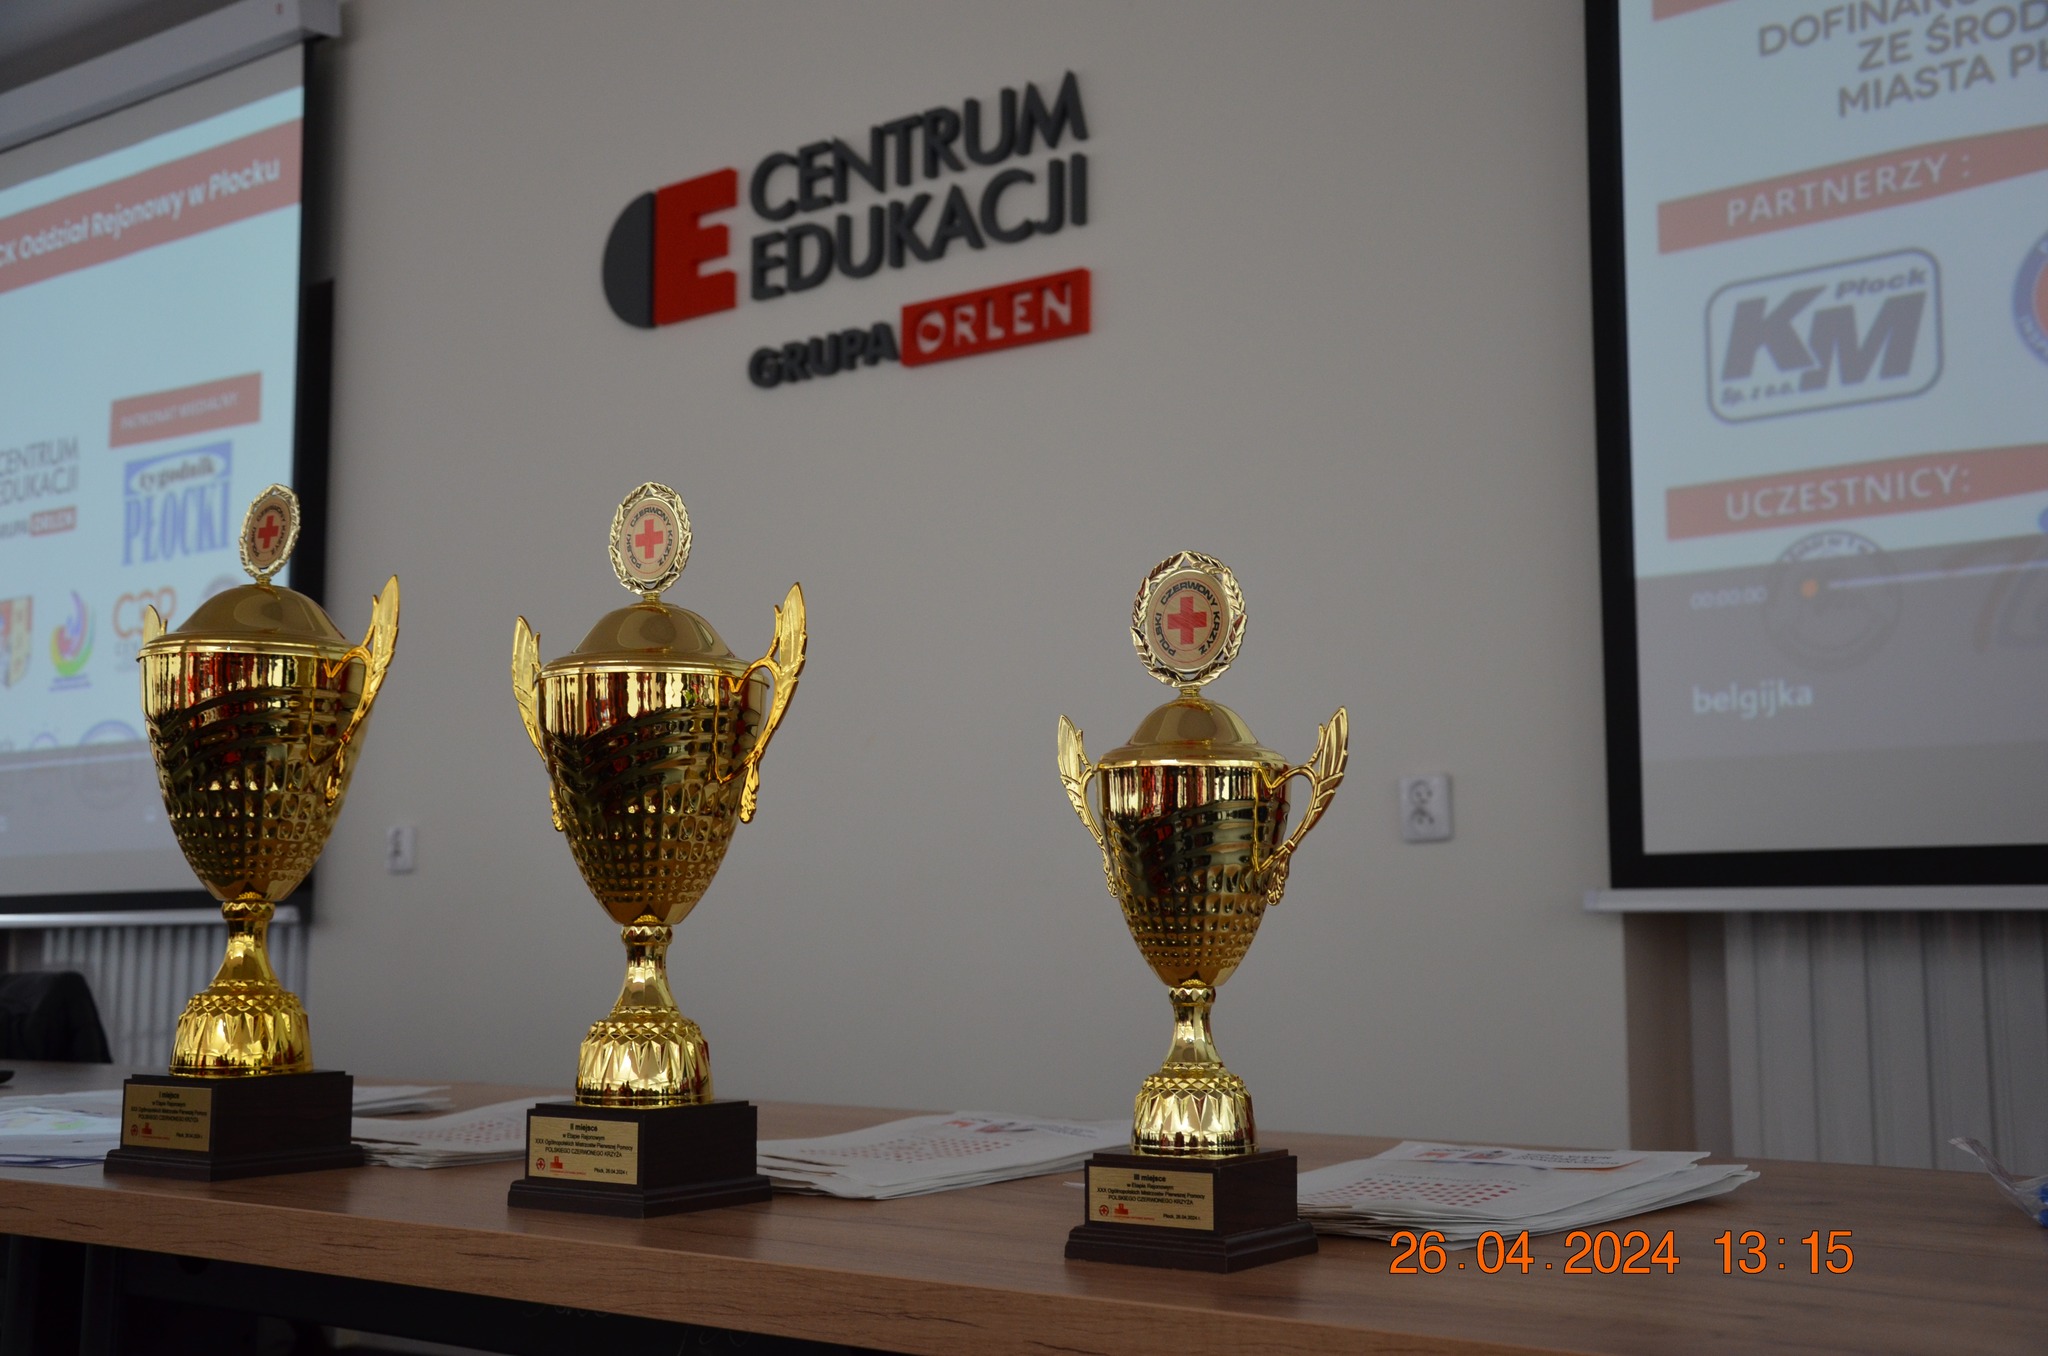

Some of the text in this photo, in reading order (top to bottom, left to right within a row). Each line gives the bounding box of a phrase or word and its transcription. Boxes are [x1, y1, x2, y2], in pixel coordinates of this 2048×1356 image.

[1758, 0, 1980, 57] DOFINA
[1858, 29, 1913, 72] ZE
[1838, 54, 1996, 118] MIASTA
[749, 69, 1090, 222] CENTRUM
[188, 184, 206, 206] w
[750, 152, 1089, 301] EDUKACJI
[748, 281, 1073, 389] GRUPA ORLEN
[0, 464, 79, 506] DUKACJI
[1725, 464, 1971, 520] UCZESTNICY:
[630, 506, 671, 528] CZERWONY
[626, 533, 642, 569] POLSKI
[1160, 581, 1218, 605] CZERWONY
[1155, 612, 1176, 656] POLSKI
[1691, 678, 1814, 719] belgijka
[575, 1123, 598, 1132] miejsce
[1141, 1174, 1166, 1182] miejsce
